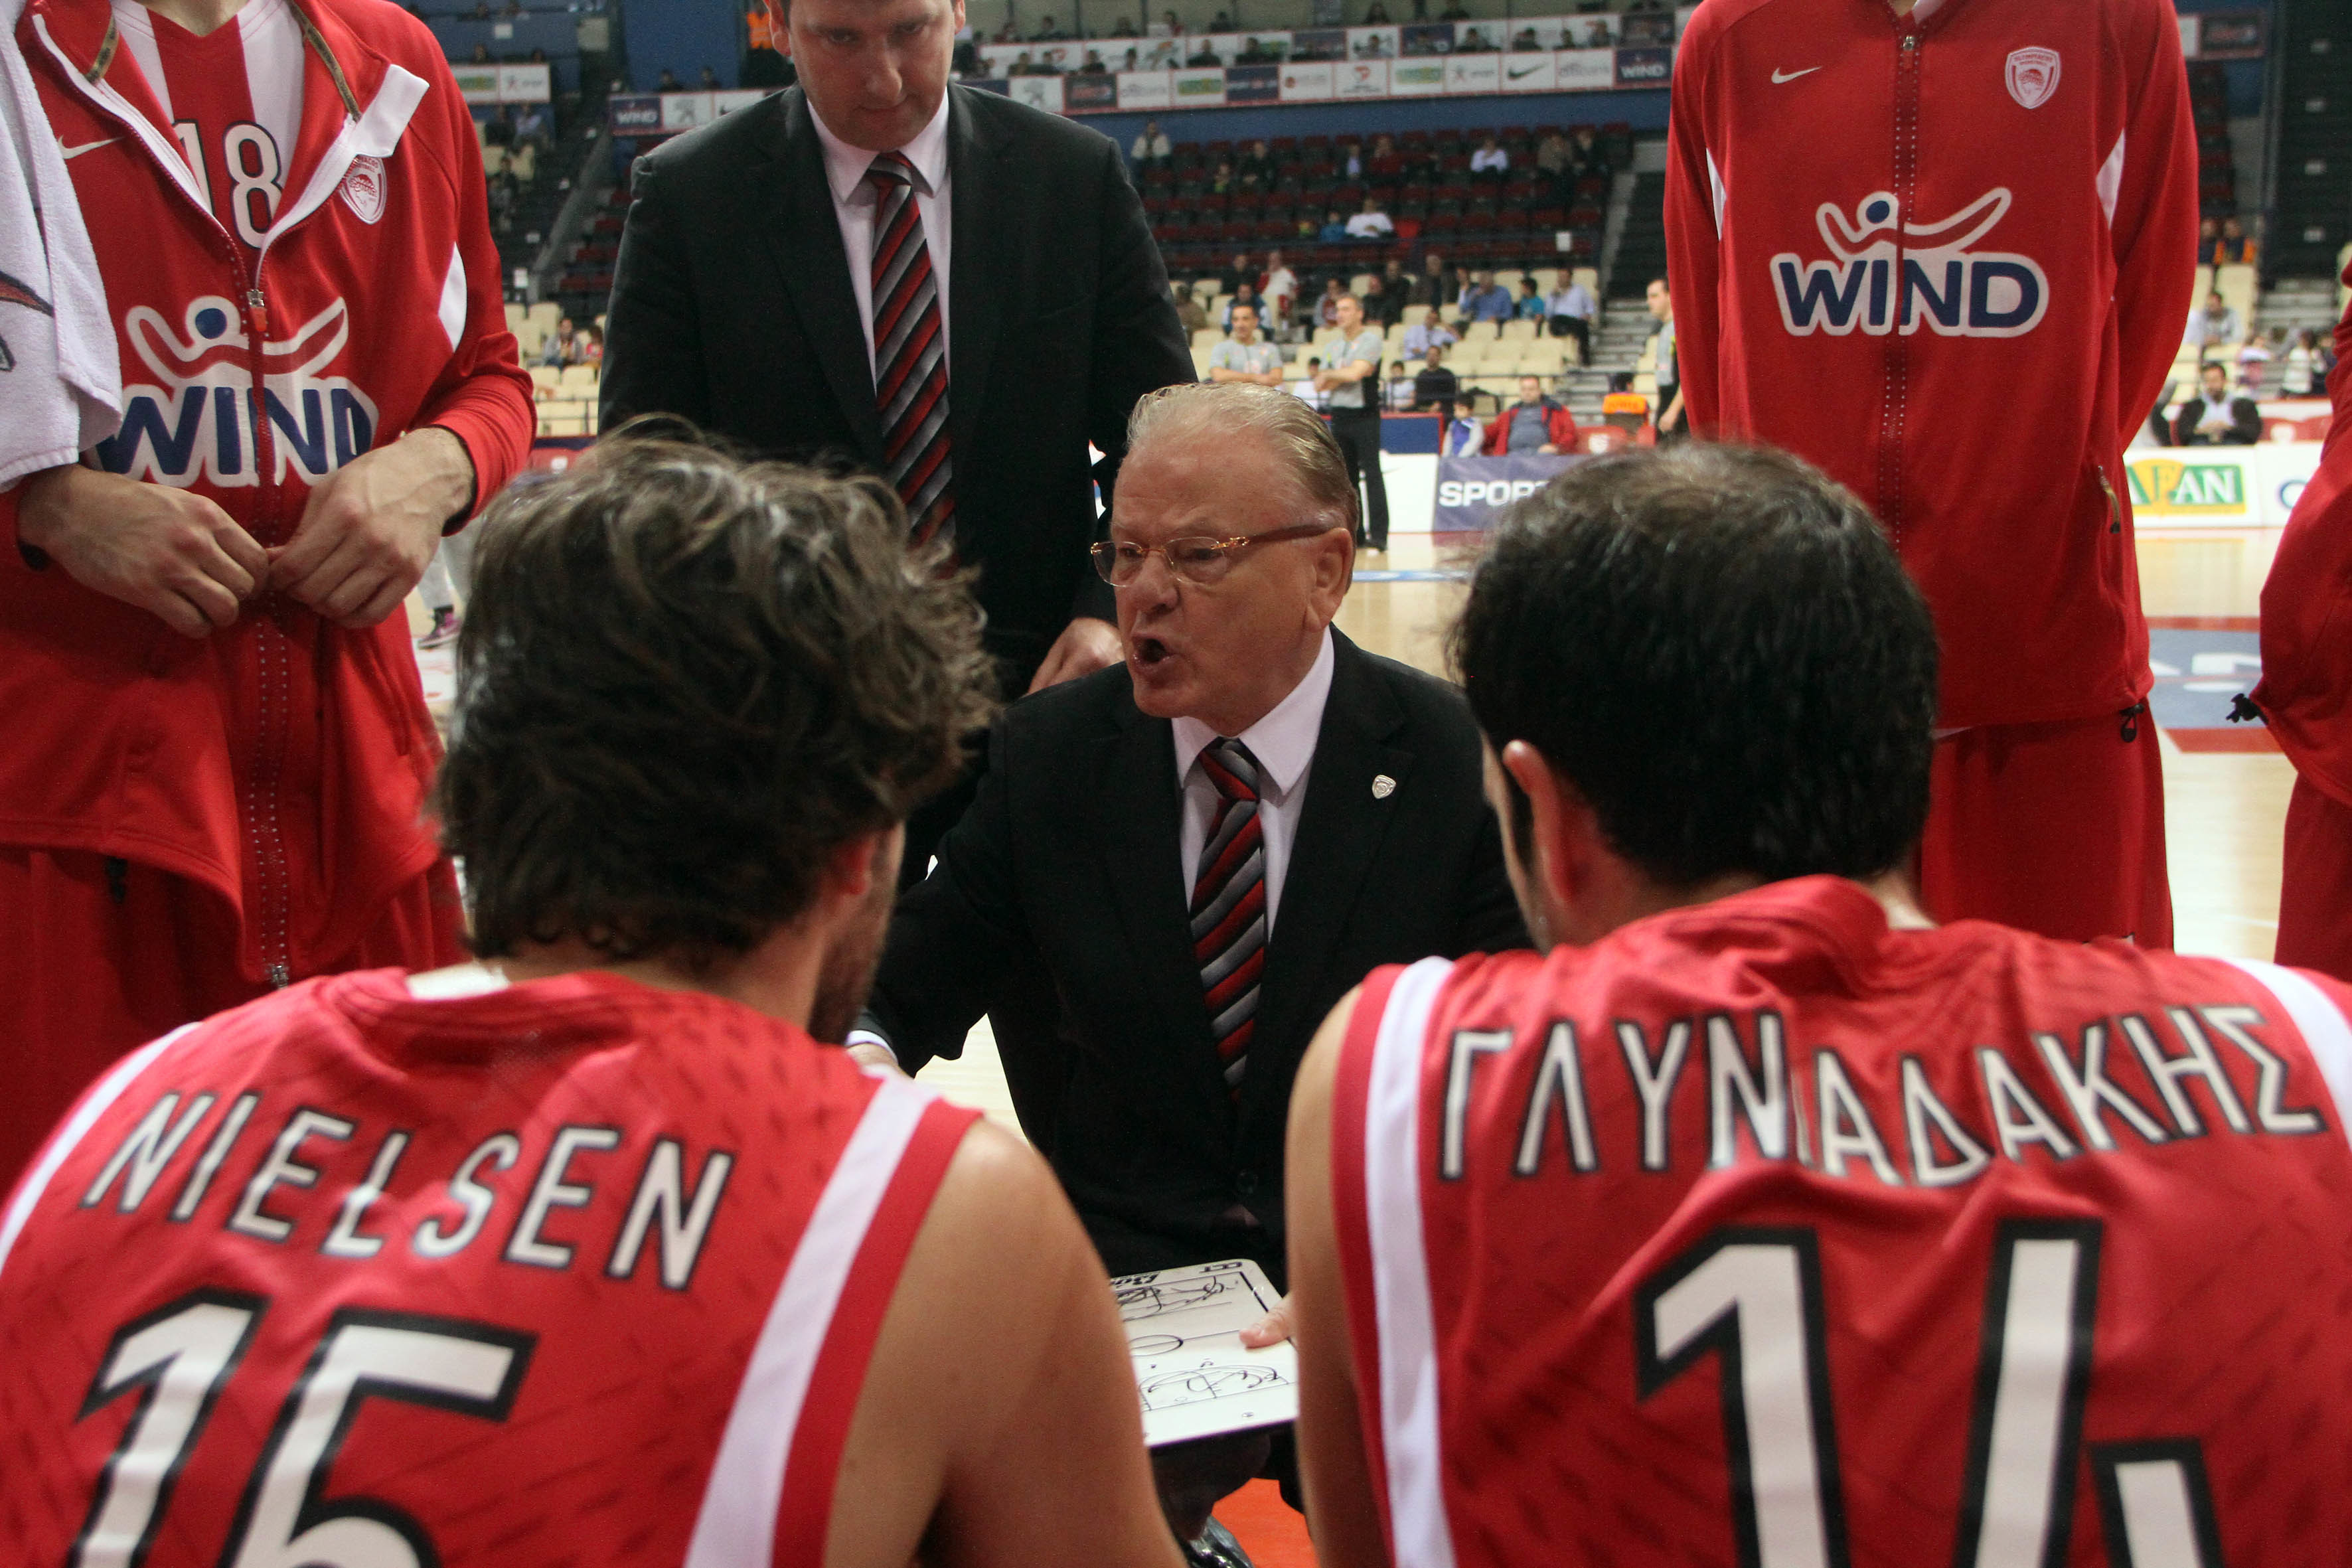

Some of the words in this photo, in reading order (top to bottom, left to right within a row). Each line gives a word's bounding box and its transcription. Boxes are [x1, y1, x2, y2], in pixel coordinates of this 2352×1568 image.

[171, 119, 284, 250] 18
[1775, 258, 2042, 329] WIND
[94, 384, 373, 477] WIND
[1439, 479, 1551, 508] SPOR
[80, 1089, 736, 1291] NIELSEN
[64, 1284, 538, 1568] 15
[1633, 1216, 2224, 1568] 14
